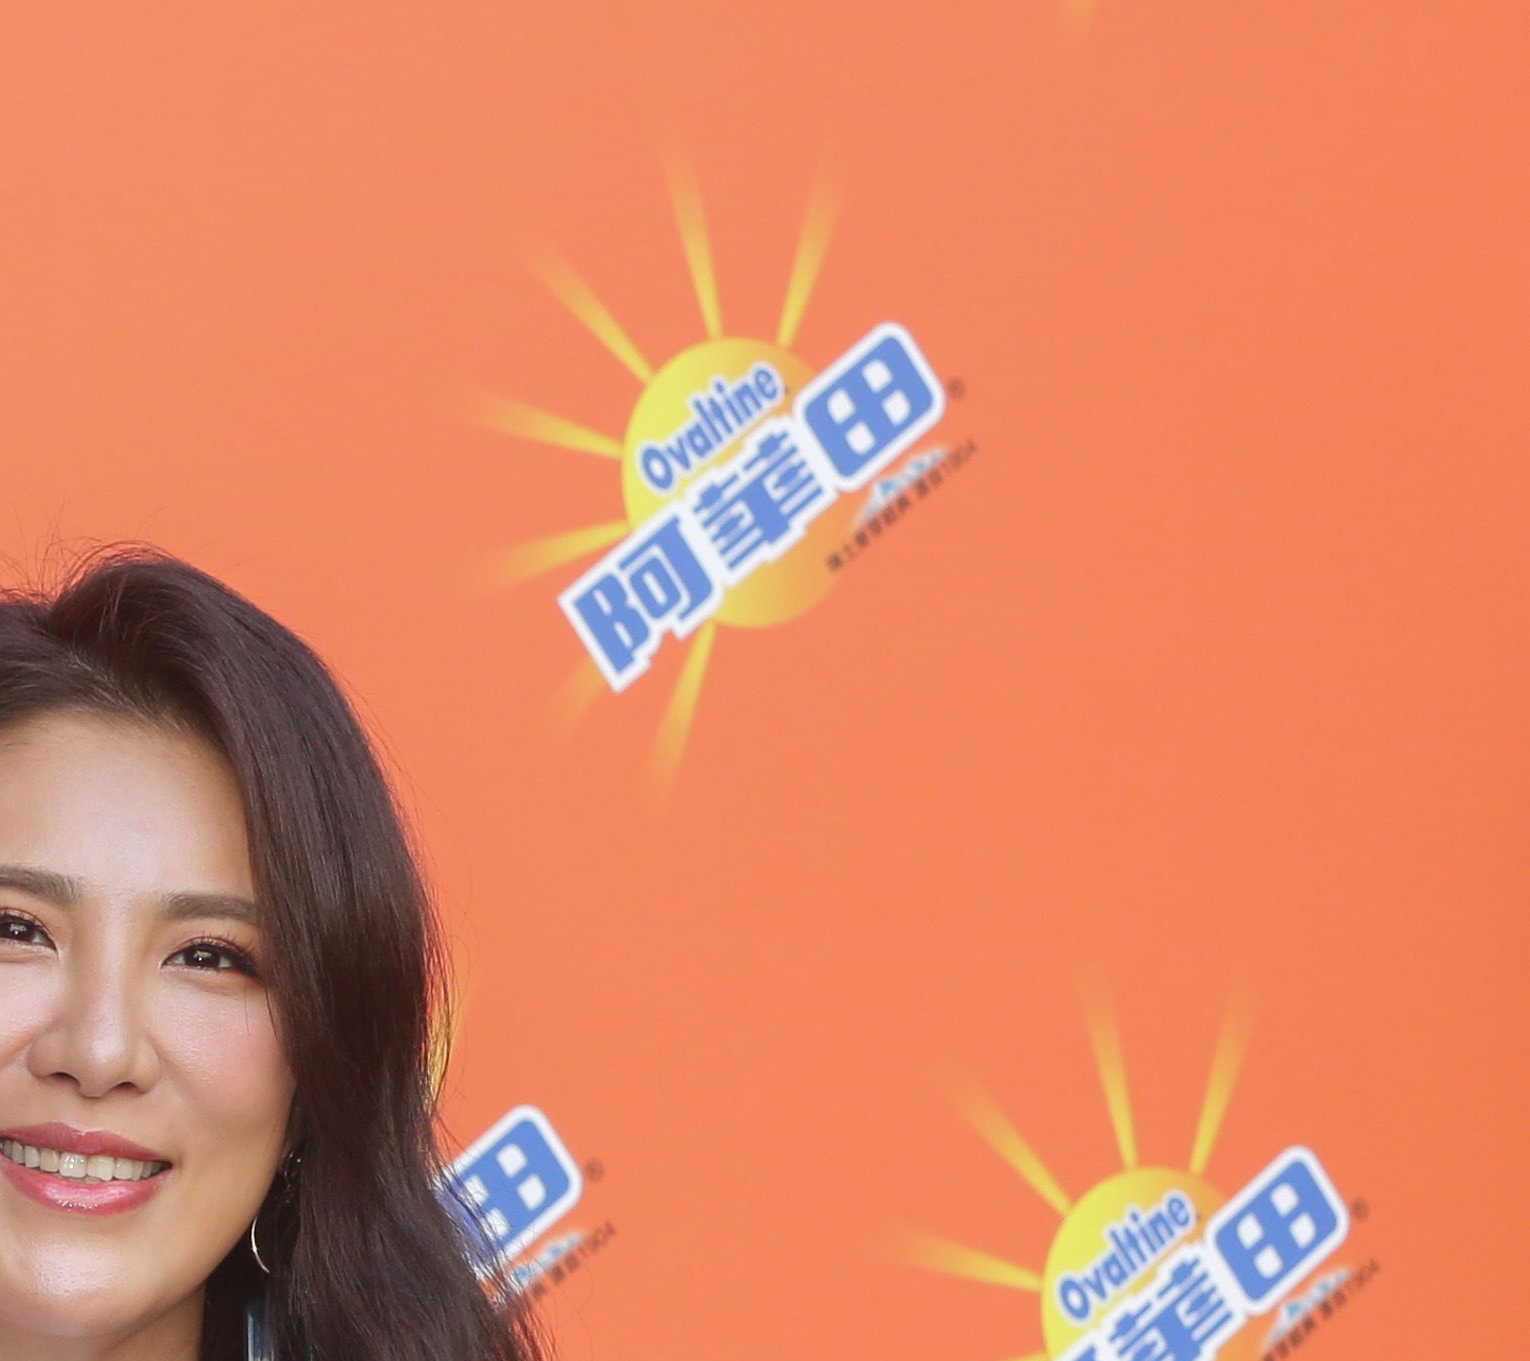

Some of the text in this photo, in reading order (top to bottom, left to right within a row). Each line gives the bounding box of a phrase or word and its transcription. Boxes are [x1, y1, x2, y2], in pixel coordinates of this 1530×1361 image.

[642, 365, 778, 490] Ovaltine
[573, 336, 934, 673] 阿華田
[1060, 1192, 1191, 1321] Ovaltine
